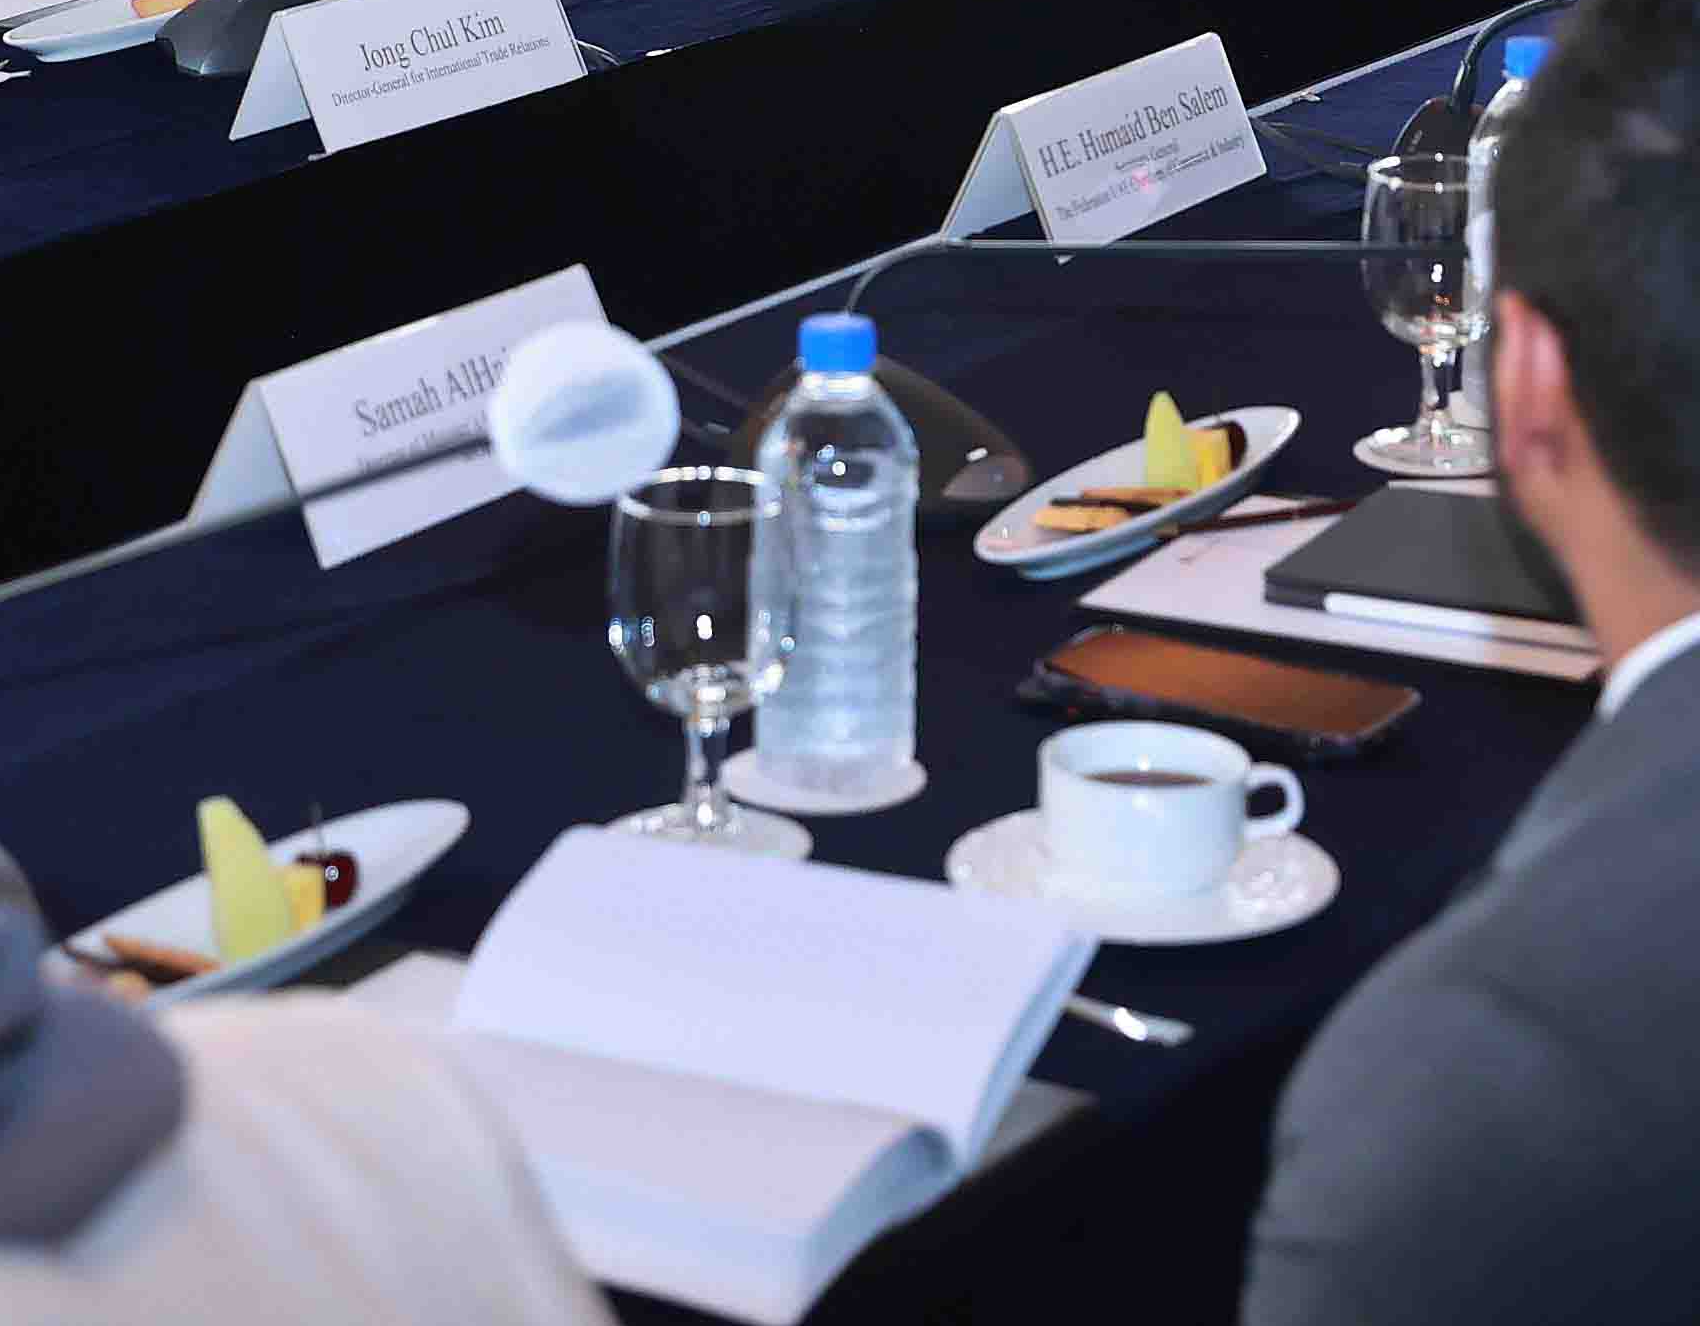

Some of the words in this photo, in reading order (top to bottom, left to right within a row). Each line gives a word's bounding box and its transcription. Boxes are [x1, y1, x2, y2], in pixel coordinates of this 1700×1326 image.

[360, 41, 410, 71] Jong
[410, 20, 458, 56] Chul
[459, 12, 505, 42] Kim
[1039, 138, 1082, 178] H.E.
[1079, 110, 1146, 161] Humaid
[1144, 105, 1180, 135] Ben
[1178, 84, 1228, 120] Salem
[355, 377, 442, 437] Samah
